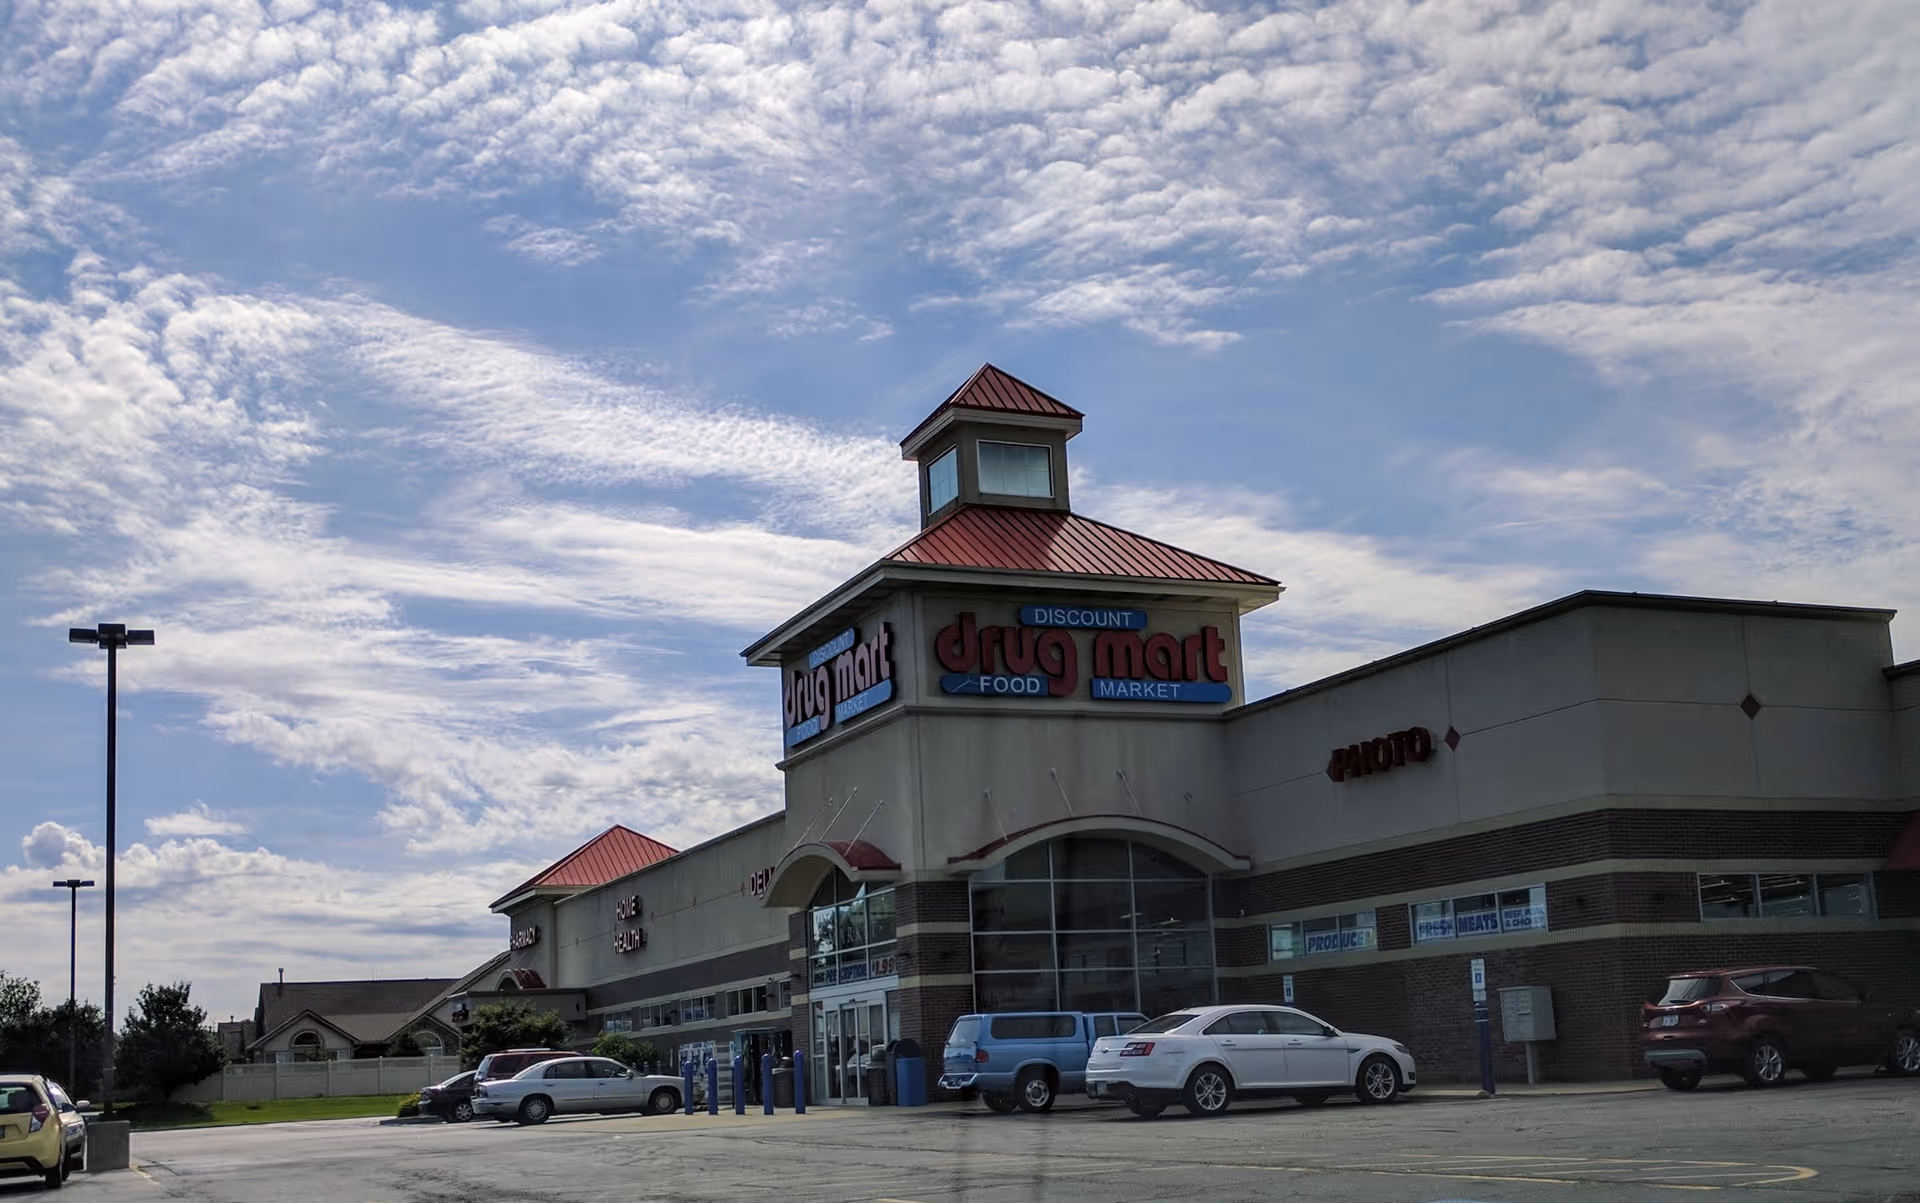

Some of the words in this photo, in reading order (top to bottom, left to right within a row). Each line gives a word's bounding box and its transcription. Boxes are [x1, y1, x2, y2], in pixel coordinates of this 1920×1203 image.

[1035, 608, 1132, 627] DISCOUNT
[813, 630, 849, 665] DISCOUNT
[935, 612, 1078, 697] drug
[1093, 626, 1228, 682] mart
[784, 665, 830, 730] drug
[836, 621, 890, 703] mart
[980, 677, 1041, 694] FOOD
[1100, 680, 1181, 699] MARKET
[796, 720, 818, 740] FOOD
[836, 692, 868, 718] MARKET
[1327, 727, 1431, 782] PHOTO
[616, 895, 639, 920] HOME
[1458, 913, 1498, 933] MEATS
[614, 927, 642, 954] HEALTH
[1308, 930, 1363, 952] PRODUCE
